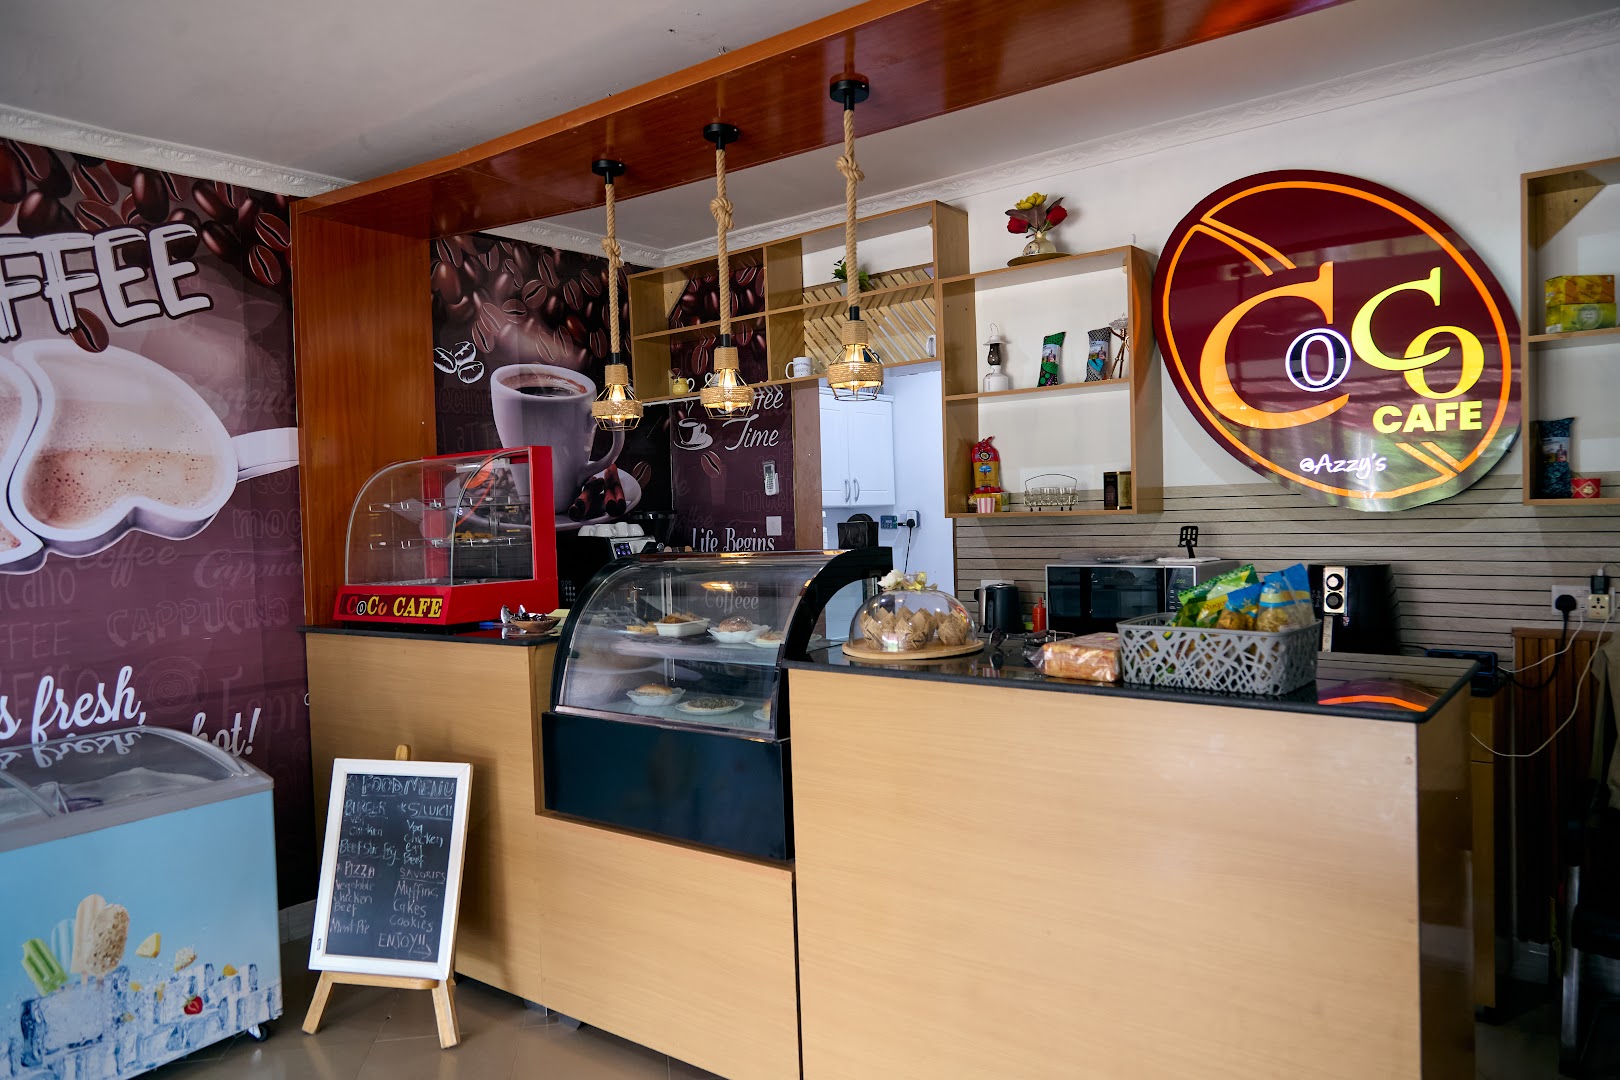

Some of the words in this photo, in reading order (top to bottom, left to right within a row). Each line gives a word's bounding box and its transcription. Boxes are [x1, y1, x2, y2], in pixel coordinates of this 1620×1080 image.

[1372, 400, 1483, 434] CAFE
[722, 413, 780, 450] Time
[1299, 453, 1388, 480] @Azzy's
[692, 527, 718, 552] Life
[722, 527, 775, 552] Begins
[393, 597, 443, 618] CAFE
[31, 665, 147, 746] fresh,
[192, 707, 262, 757] hot!
[361, 776, 403, 795] FOOD
[404, 777, 455, 797] MENU
[345, 799, 386, 816] BURGER
[344, 860, 375, 877] PIZZA
[393, 898, 427, 918] Cakes
[356, 919, 370, 934] Pie
[389, 914, 433, 933] Cookies
